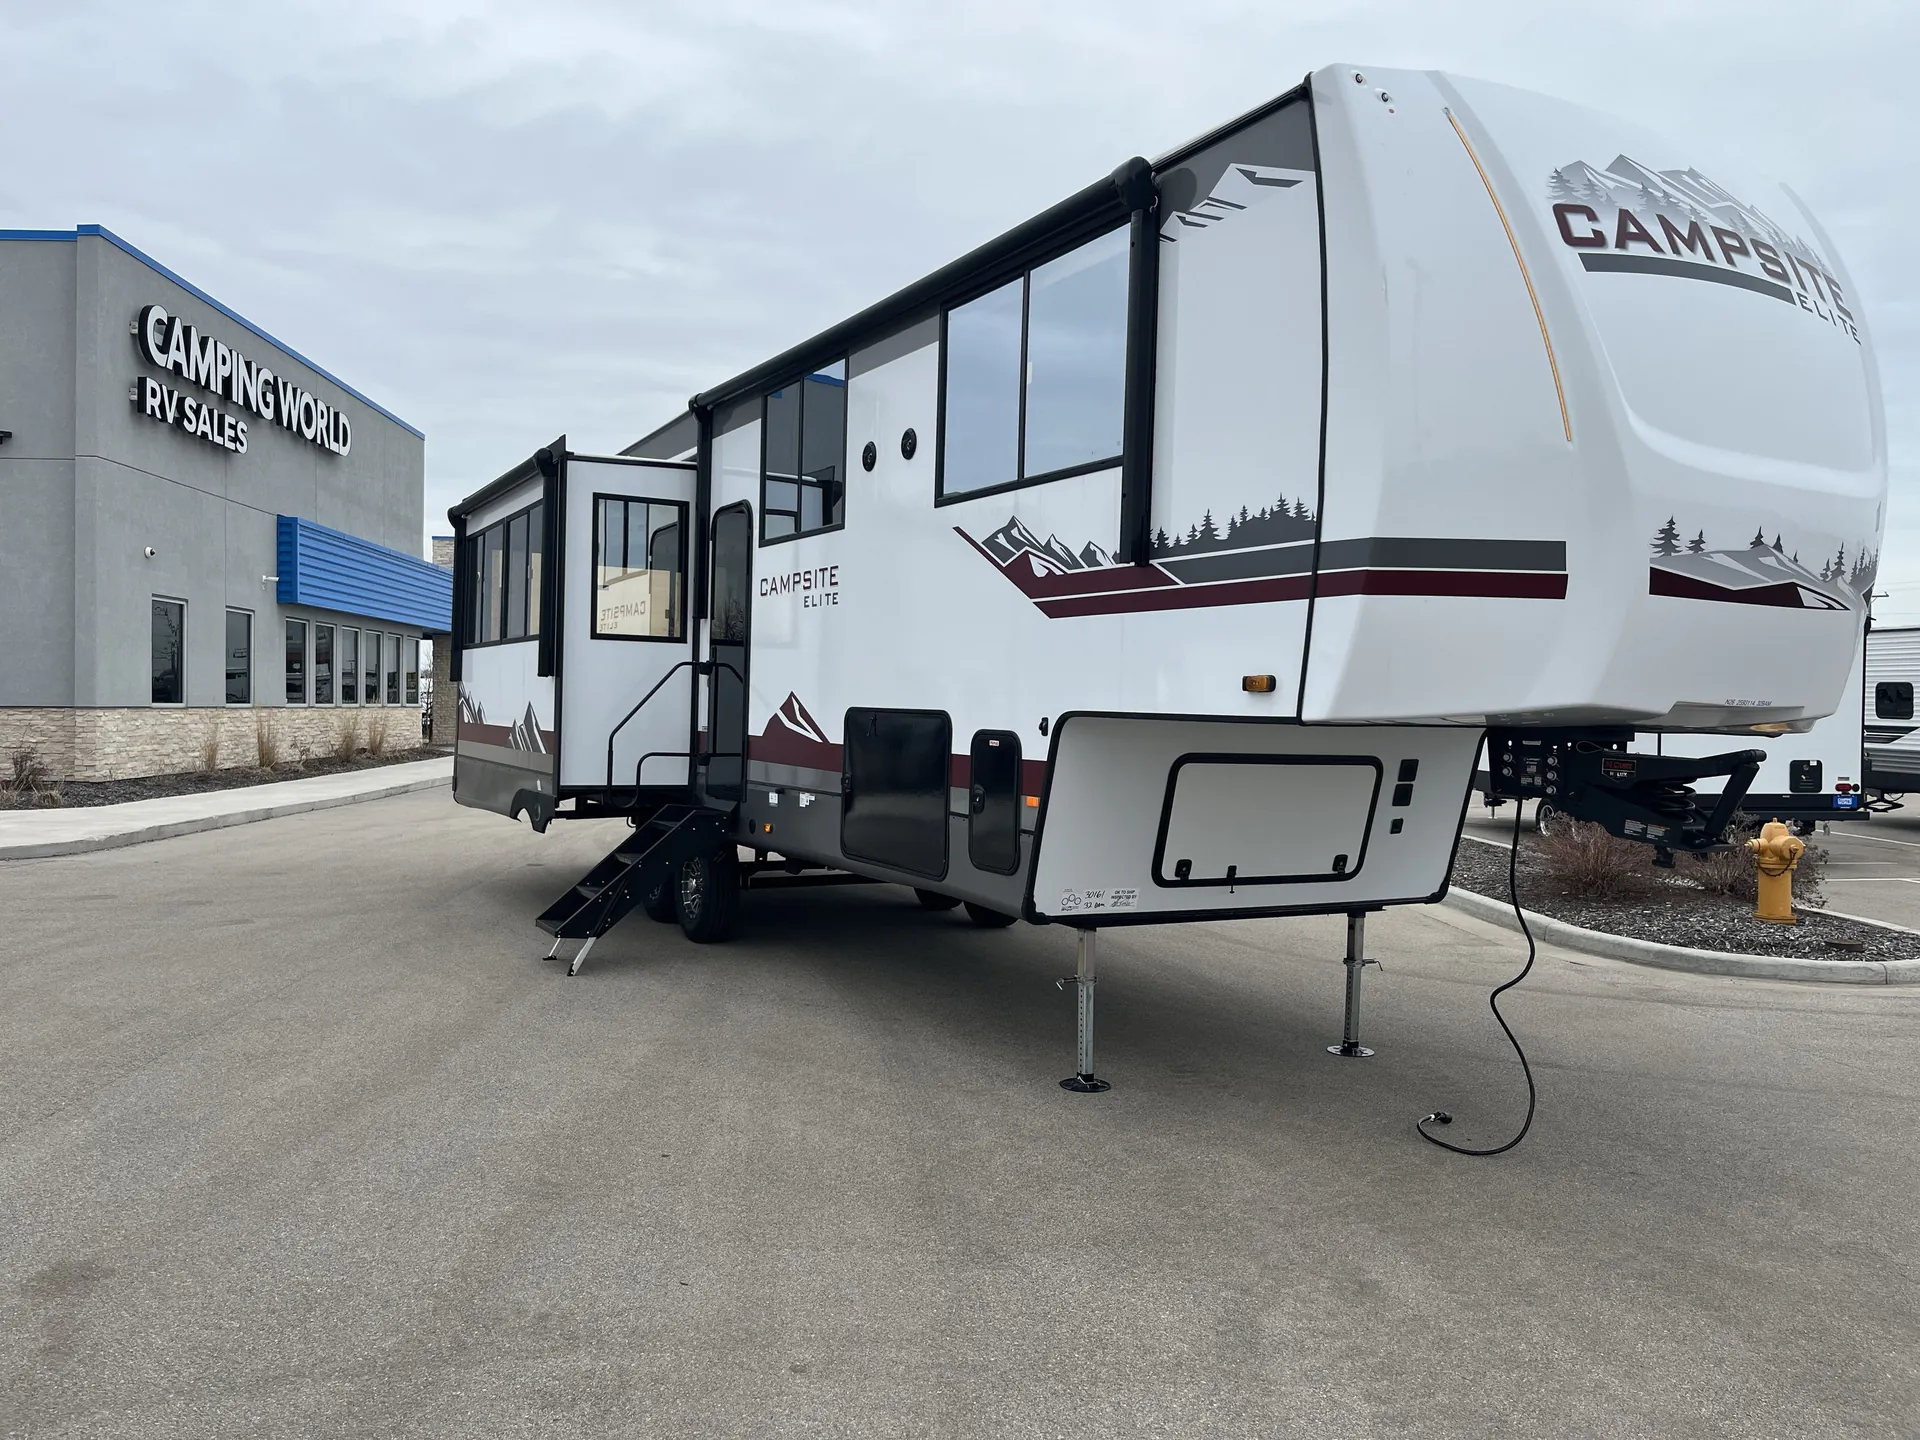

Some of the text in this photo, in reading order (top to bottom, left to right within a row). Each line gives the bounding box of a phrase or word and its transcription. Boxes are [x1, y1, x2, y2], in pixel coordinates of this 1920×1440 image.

[1552, 203, 1854, 322] CAMPSITE
[1795, 291, 1862, 346] ELITE
[144, 304, 352, 457] CAMPING WORLD
[145, 376, 249, 455] RV SALES
[760, 565, 839, 597] CAMPSITE
[803, 592, 839, 608] ELITE
